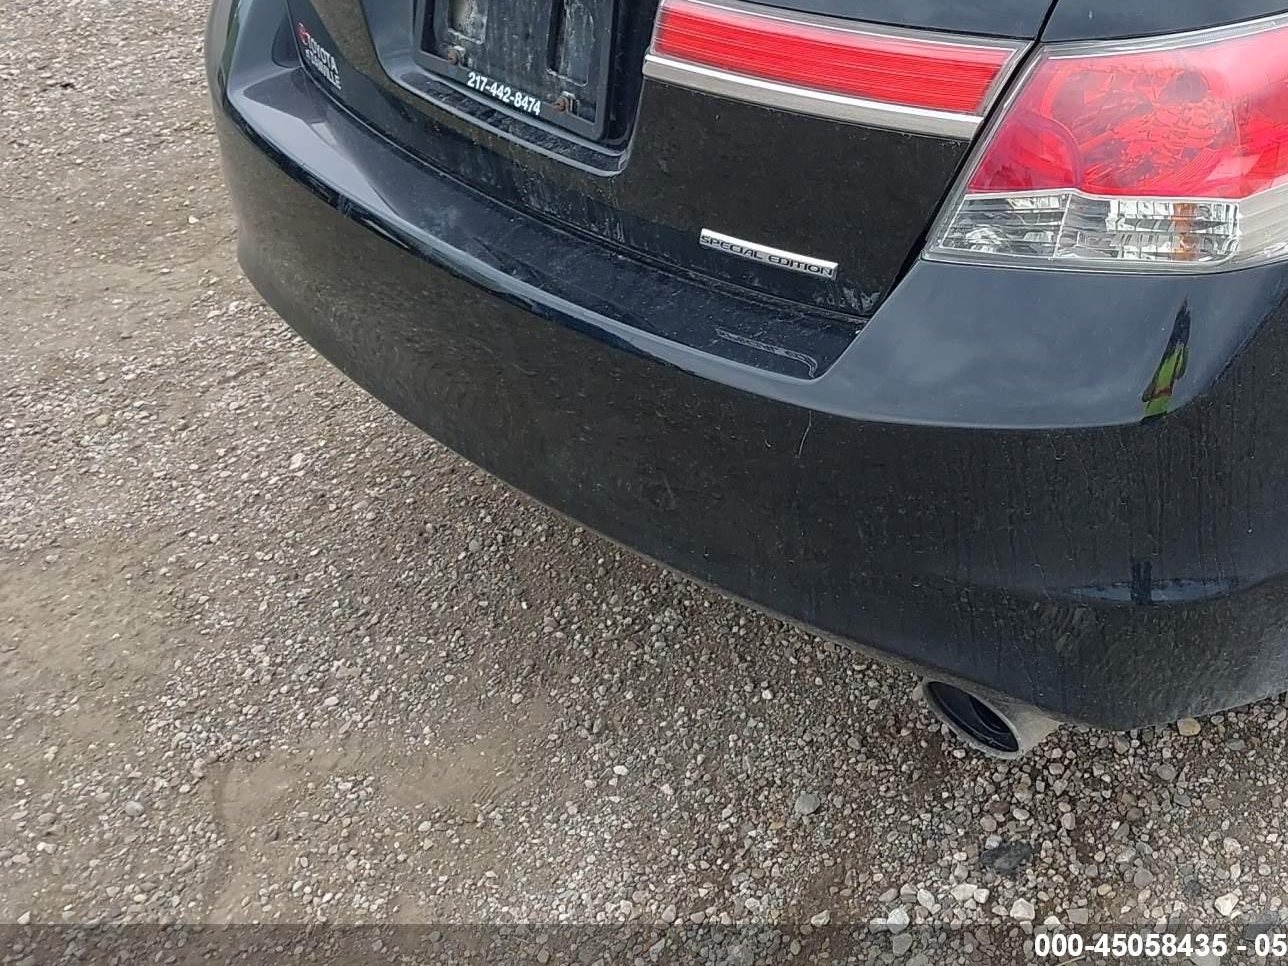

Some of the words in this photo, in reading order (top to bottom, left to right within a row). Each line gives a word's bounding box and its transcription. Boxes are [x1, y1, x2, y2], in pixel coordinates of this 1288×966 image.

[467, 71, 541, 116] 217-442-8474
[700, 234, 763, 260] SPECIAL
[768, 254, 833, 276] EDITION
